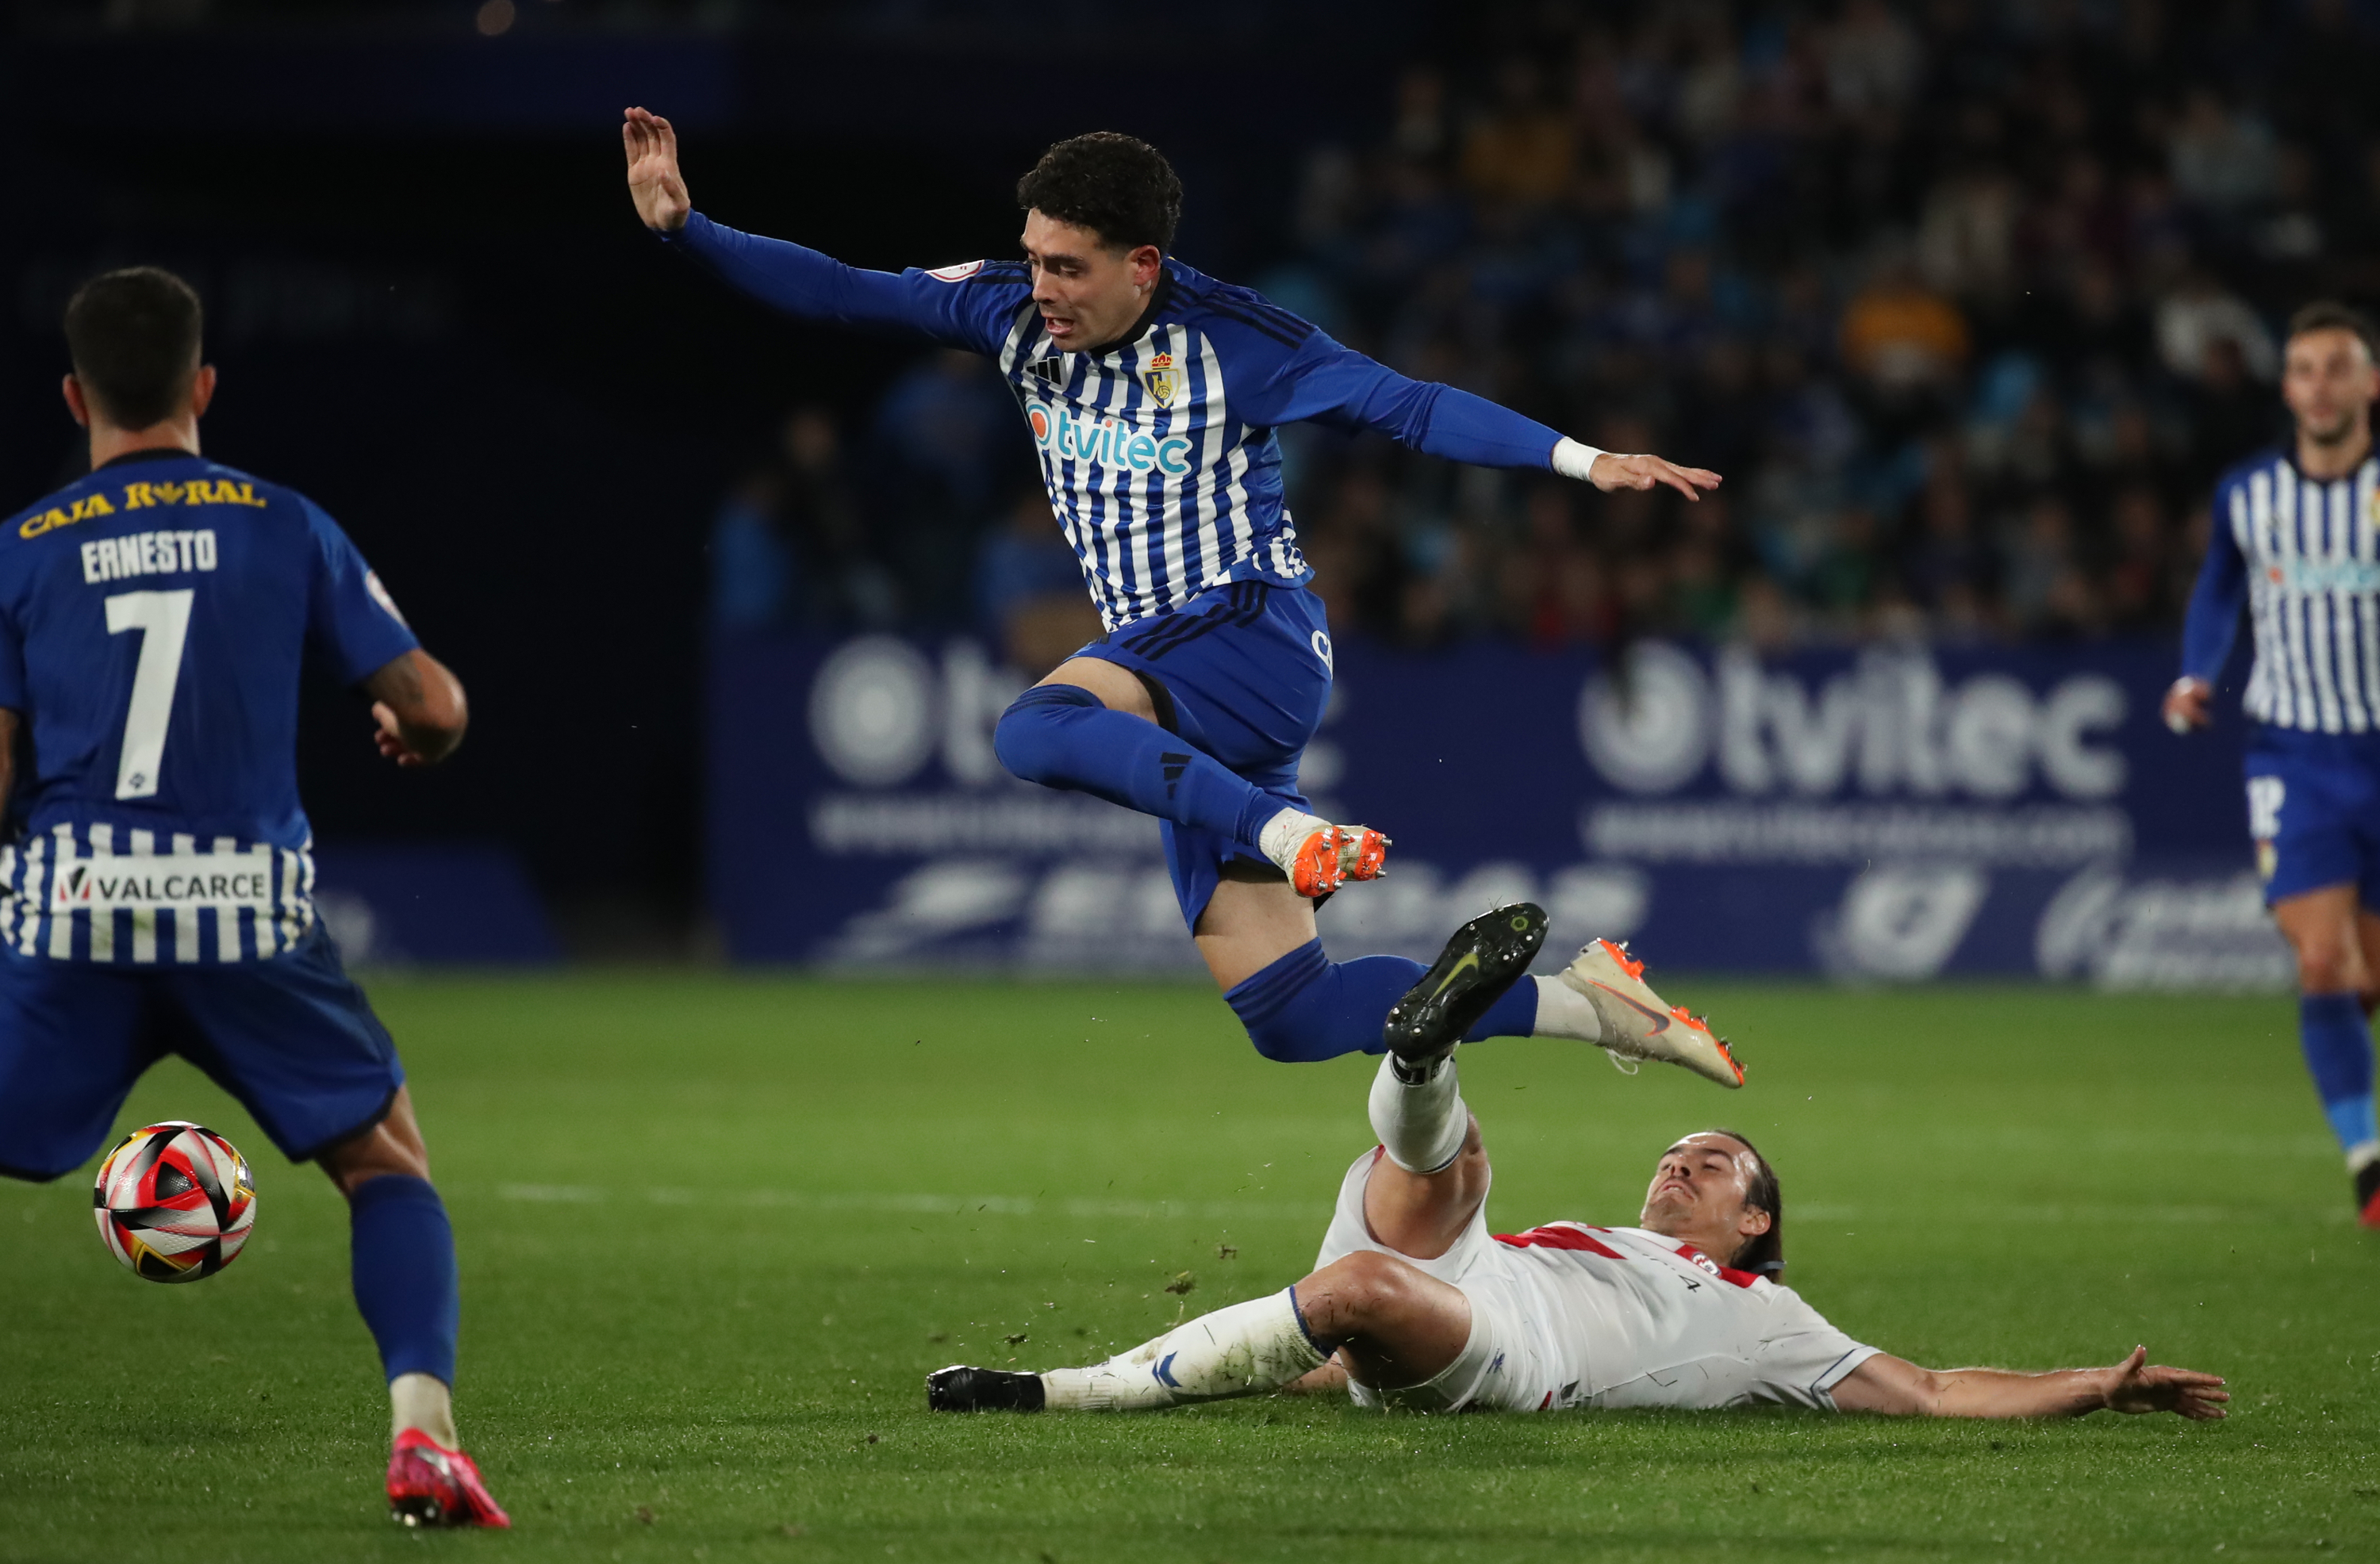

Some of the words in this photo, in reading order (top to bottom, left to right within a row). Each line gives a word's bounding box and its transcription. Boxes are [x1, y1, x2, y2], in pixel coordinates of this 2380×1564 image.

[1058, 411, 1188, 473] tvitec
[19, 493, 116, 539] CAJA
[81, 529, 218, 585] ERNESTO
[105, 588, 194, 800] 7
[98, 873, 266, 902] VALCARCE
